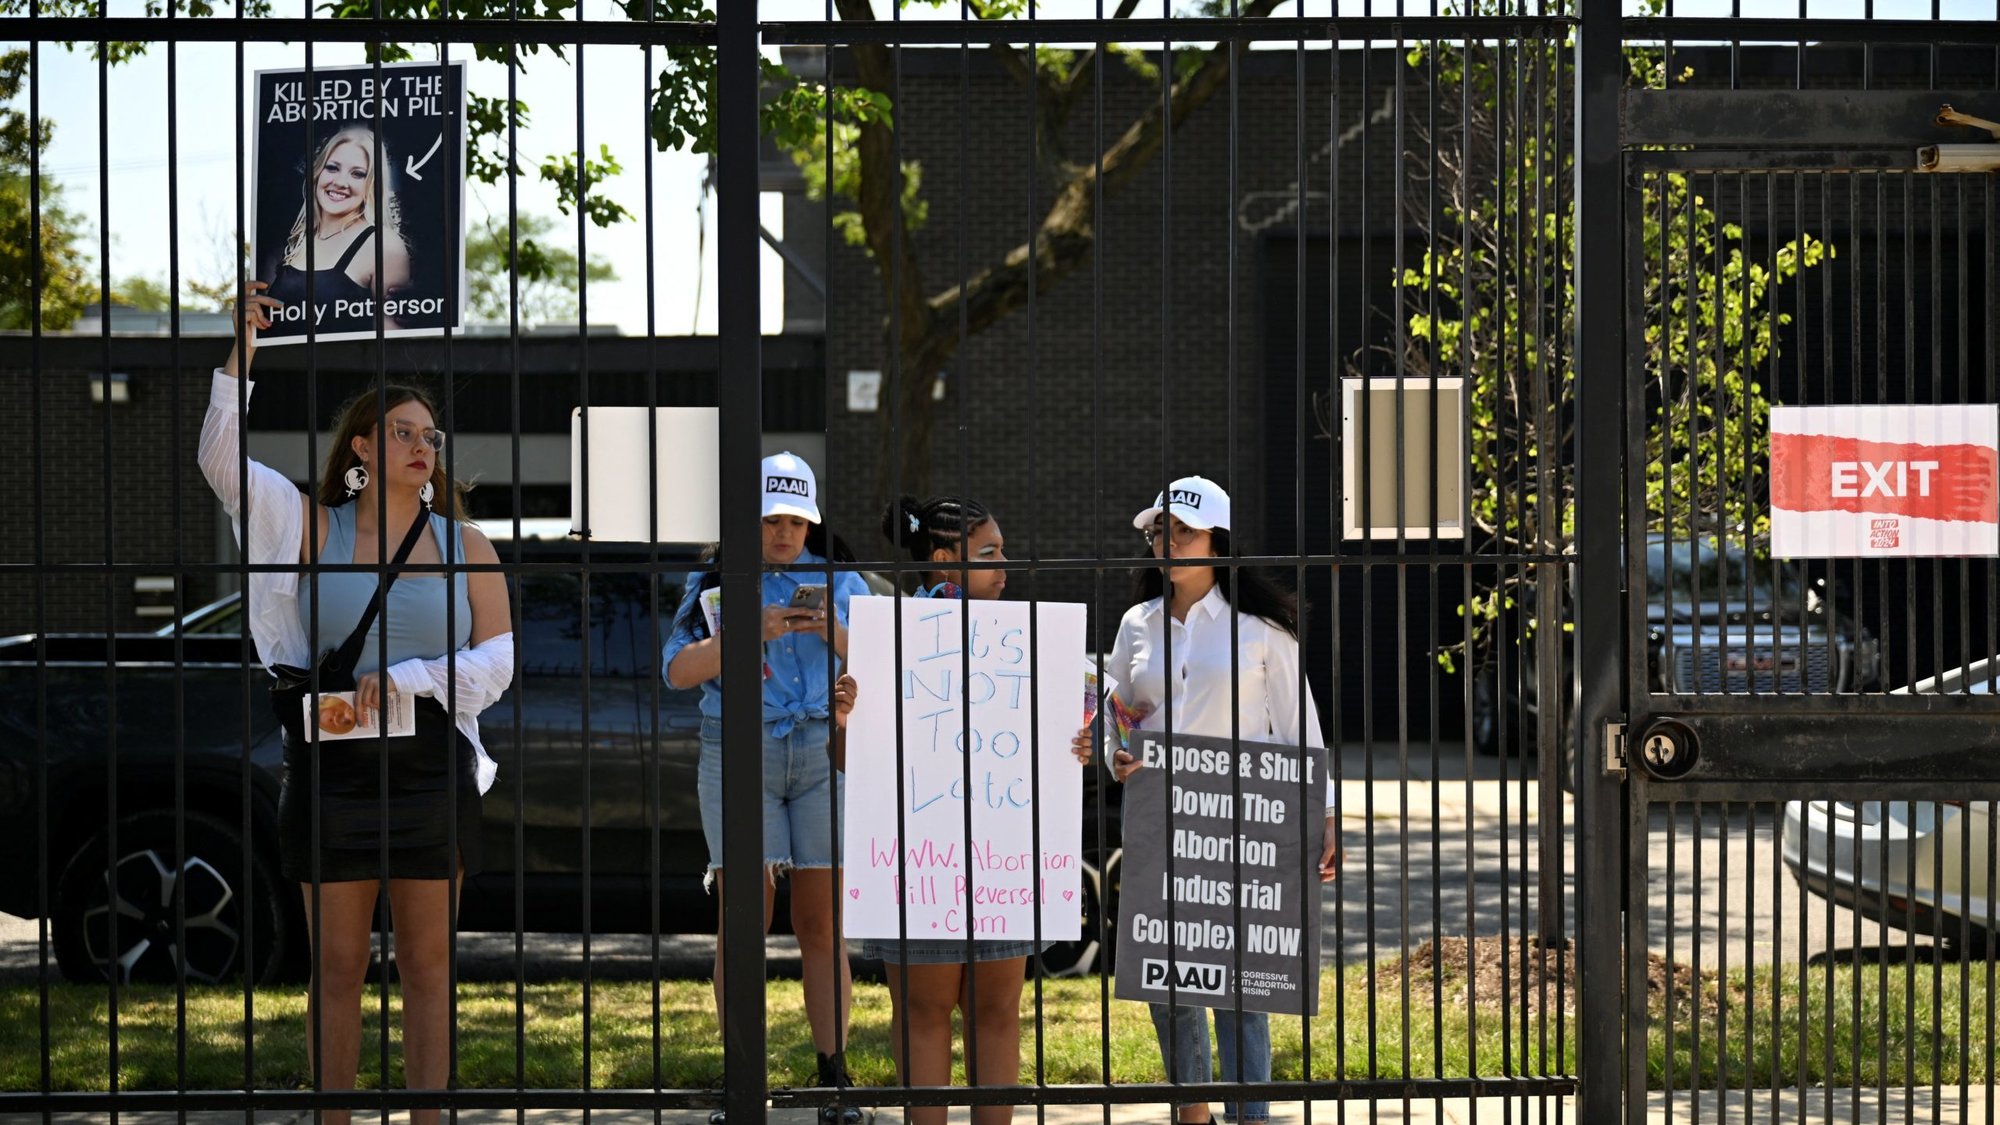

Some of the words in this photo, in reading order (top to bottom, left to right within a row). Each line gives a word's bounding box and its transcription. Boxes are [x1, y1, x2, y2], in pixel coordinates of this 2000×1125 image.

[274, 80, 352, 102] KILED
[361, 77, 392, 98] BY
[400, 75, 443, 96] THE
[408, 96, 454, 117] PIL
[269, 300, 328, 326] Holy
[335, 297, 446, 319] Paterso
[768, 477, 808, 496] PAAU
[1831, 460, 1939, 498] EXIT
[1870, 529, 1900, 538] ACTION
[1873, 519, 1896, 529] INTO
[1873, 537, 1896, 547] 2024
[918, 611, 1024, 664] It's
[903, 669, 1032, 709] NOT
[1143, 739, 1230, 775] Expose
[1239, 752, 1252, 778] &
[1260, 752, 1315, 784] Shut
[1171, 785, 1234, 820] Down
[1243, 792, 1286, 824] The
[1162, 872, 1282, 911] Indusrial
[1132, 913, 1235, 951] Complex
[1146, 962, 1222, 991] PAAU
[1232, 969, 1289, 982] OGRESSIVE
[1231, 985, 1271, 997] RISING
